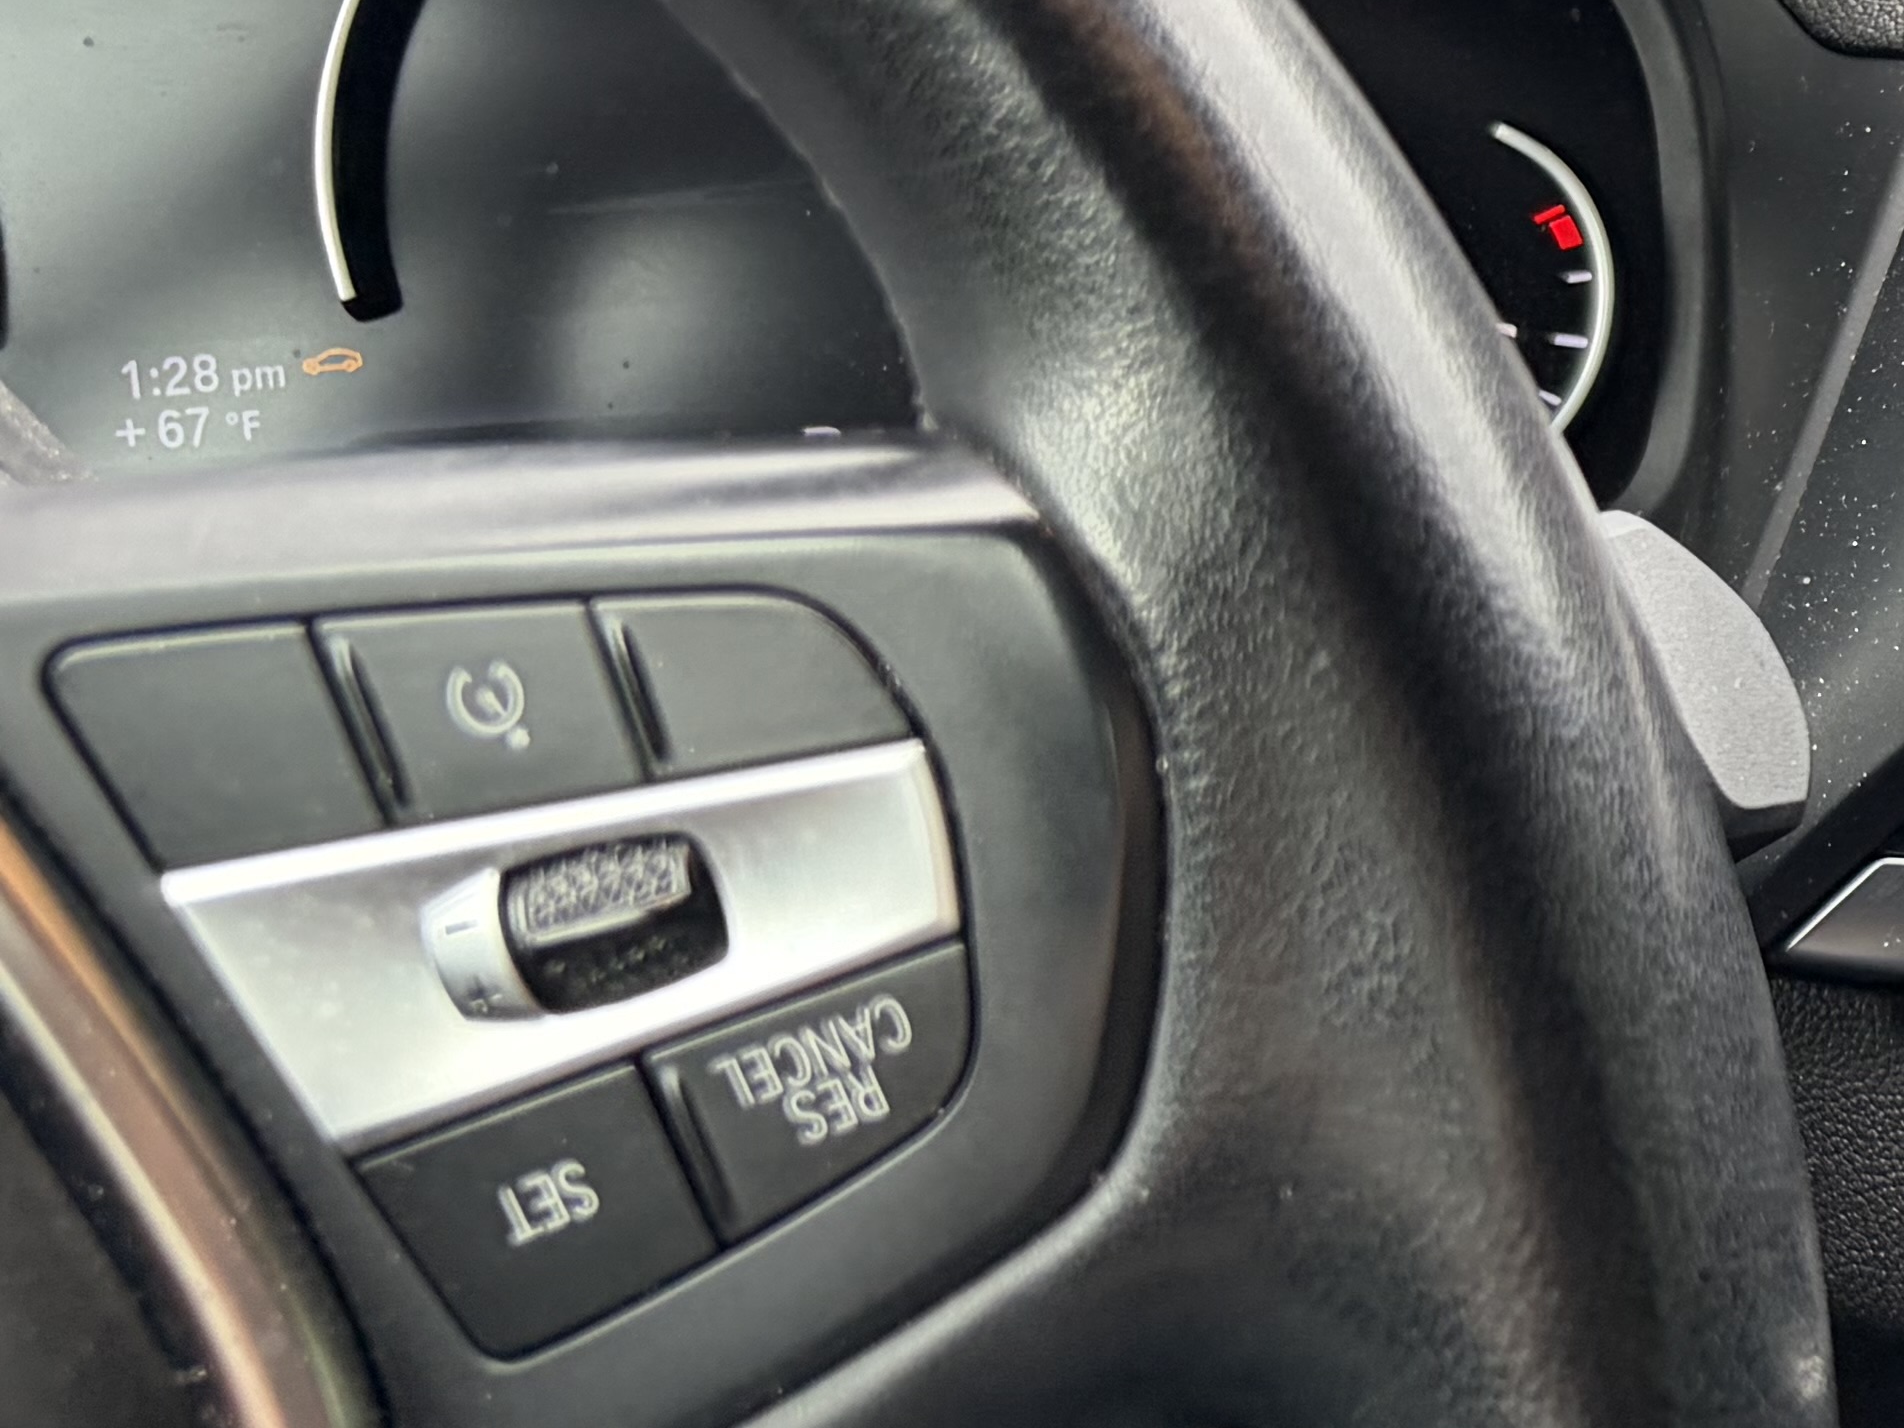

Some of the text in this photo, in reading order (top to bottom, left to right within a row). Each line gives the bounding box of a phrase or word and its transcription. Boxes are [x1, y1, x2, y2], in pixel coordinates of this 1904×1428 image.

[121, 354, 287, 400] 1:28 pm
[226, 410, 261, 440] °F
[708, 993, 912, 1107] CANCEL
[780, 1068, 889, 1143] RES
[496, 1160, 600, 1245] SET
